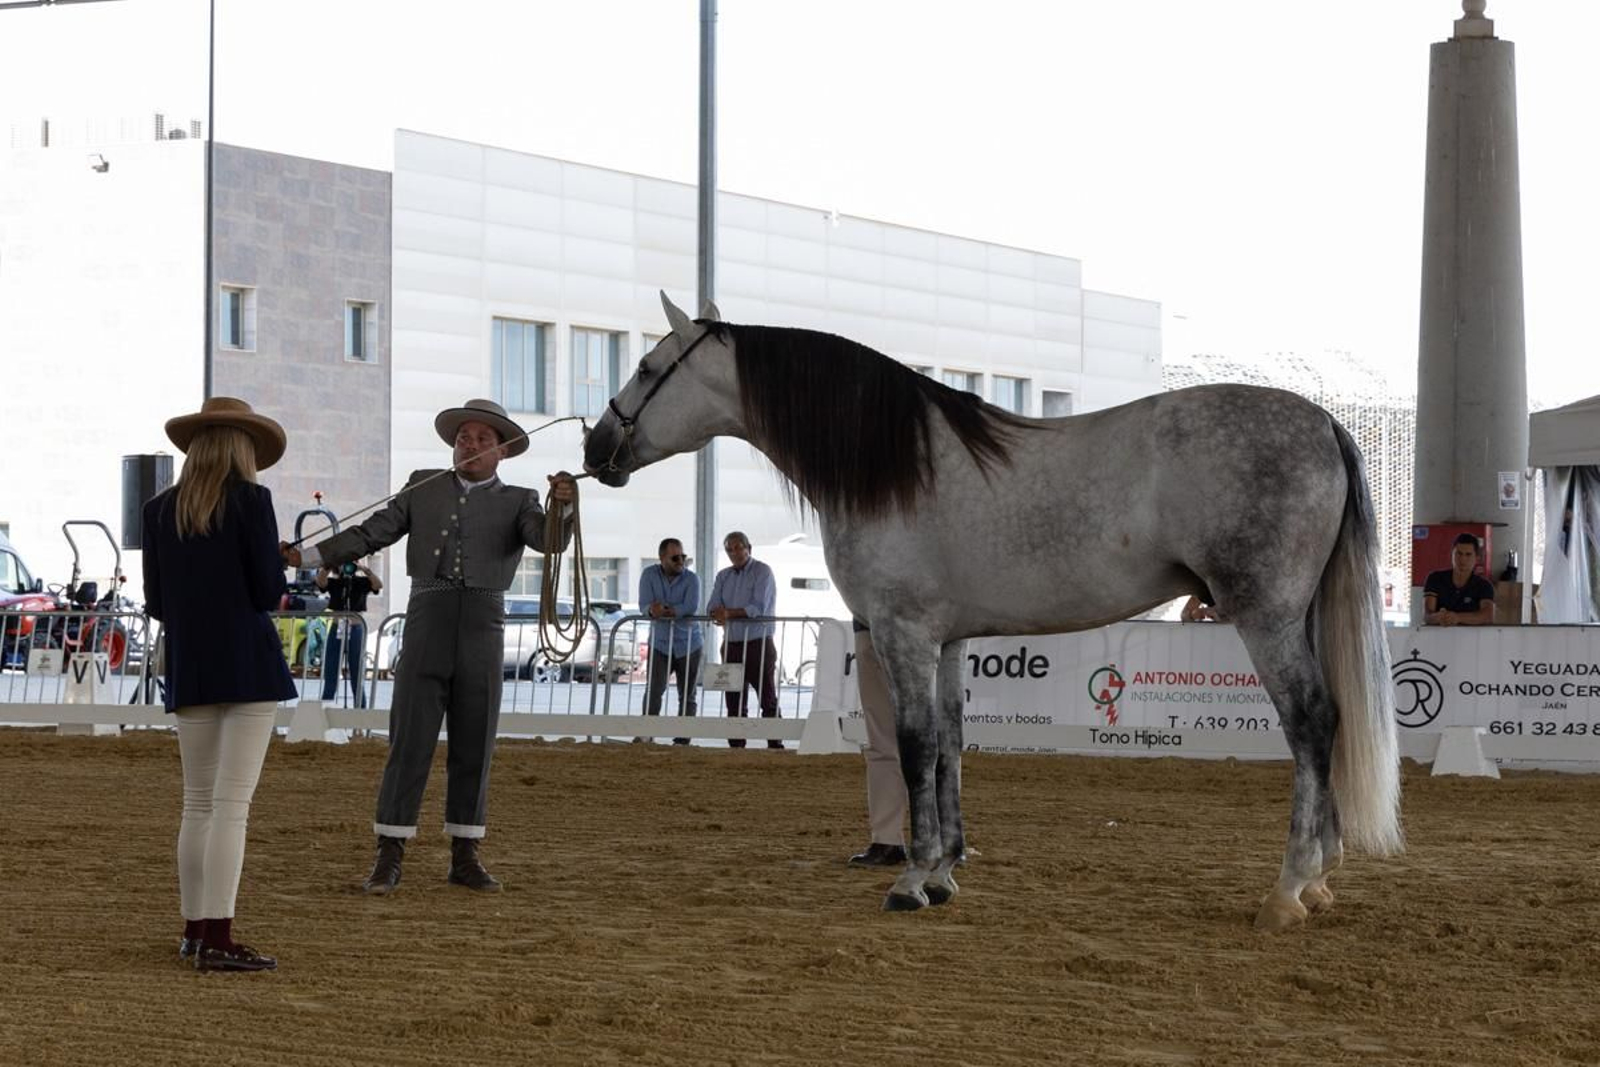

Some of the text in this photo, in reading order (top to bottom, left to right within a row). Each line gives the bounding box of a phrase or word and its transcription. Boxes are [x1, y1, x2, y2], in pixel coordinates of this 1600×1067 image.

[73, 659, 89, 684] V
[1510, 660, 1600, 676] YEGUADA
[1132, 671, 1262, 687] ANTONIO OCHA
[1459, 681, 1555, 697] OCHANDO
[1131, 691, 1214, 704] INSTALACIONES
[1217, 692, 1225, 704] Y
[1015, 712, 1054, 725] bodas
[1089, 728, 1130, 744] Tono
[1489, 720, 1523, 736] 661
[1531, 721, 1557, 736] 32
[1562, 722, 1588, 736] 43
